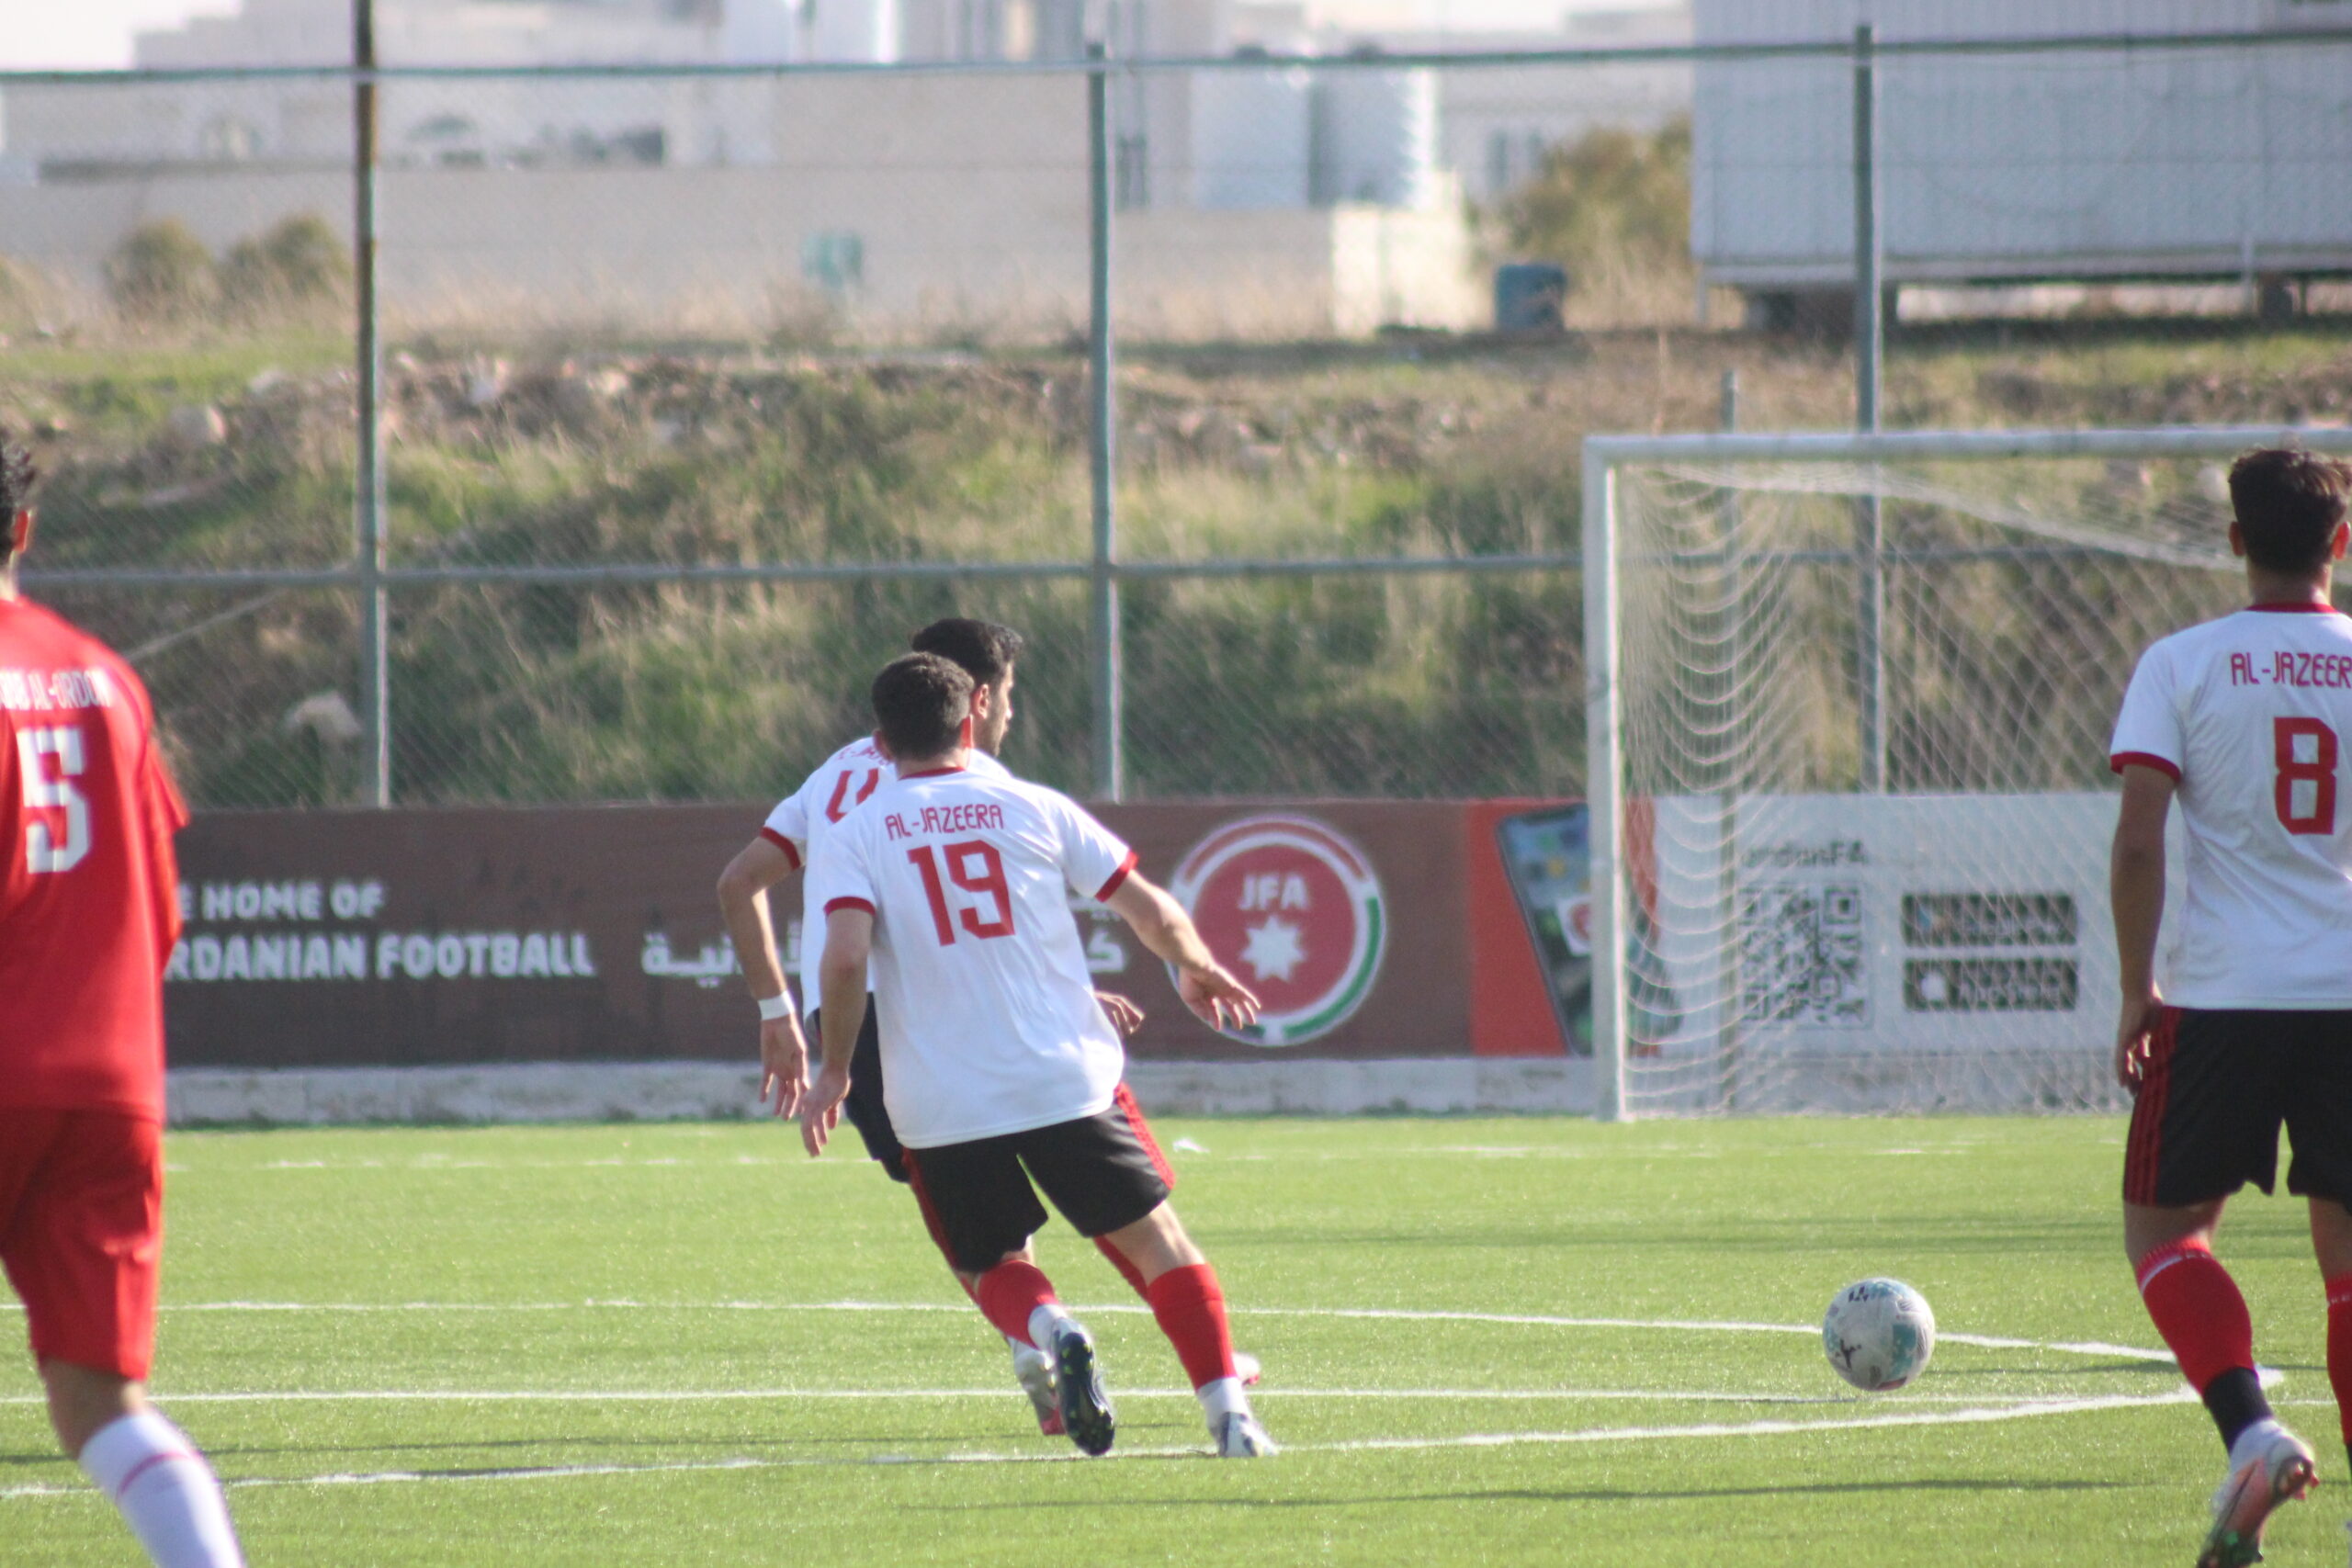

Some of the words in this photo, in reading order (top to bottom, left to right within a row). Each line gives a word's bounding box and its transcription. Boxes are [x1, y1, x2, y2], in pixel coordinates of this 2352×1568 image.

[2230, 651, 2352, 688] AL-JAZEER
[2273, 716, 2338, 836] 8
[17, 726, 90, 874] 5
[884, 803, 1005, 841] AL-JAZEERA
[201, 882, 322, 920] HOME
[330, 882, 384, 919] OF
[906, 839, 1016, 947] 19
[1237, 873, 1309, 911] JFA
[164, 931, 367, 981] RDANIAN
[375, 931, 597, 980] FOOTBALL
